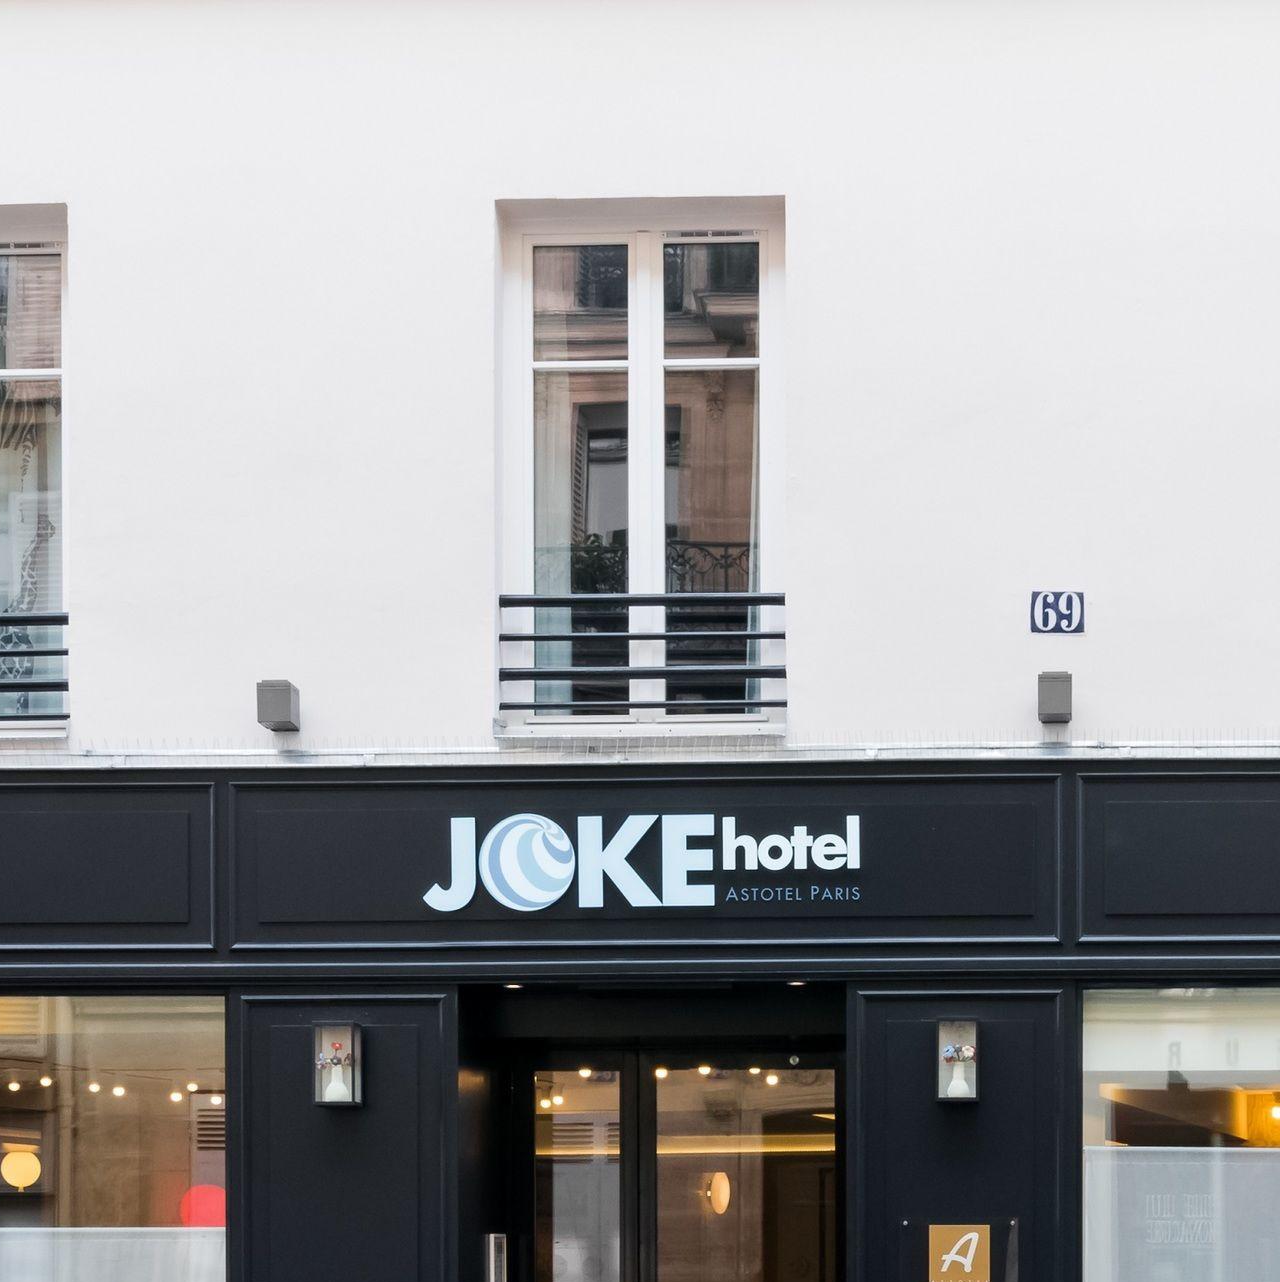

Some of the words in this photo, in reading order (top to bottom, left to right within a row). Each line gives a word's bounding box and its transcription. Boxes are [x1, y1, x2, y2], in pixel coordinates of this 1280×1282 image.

[1033, 591, 1082, 632] 69
[422, 813, 716, 912] JOKE
[722, 815, 861, 871] hotel
[725, 886, 802, 902] ASTOTEL
[811, 885, 861, 901] PARIS
[940, 1231, 980, 1273] A
